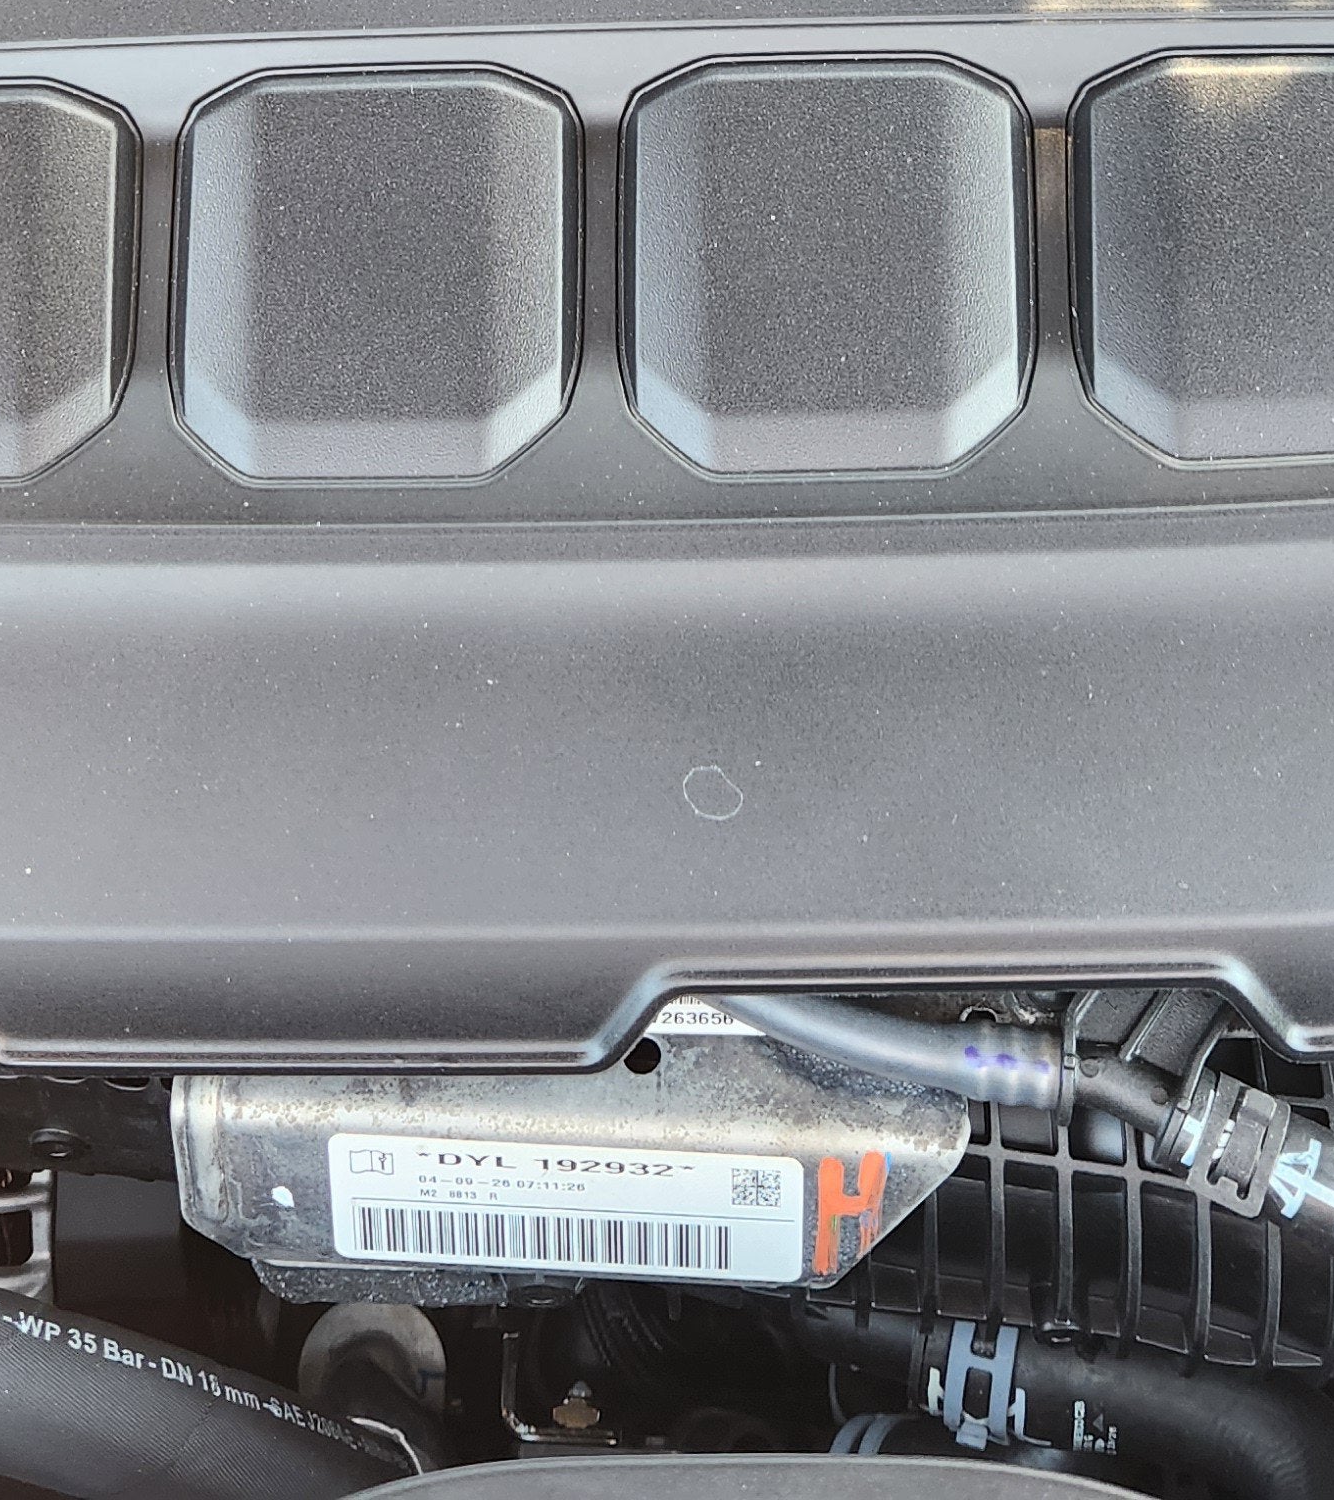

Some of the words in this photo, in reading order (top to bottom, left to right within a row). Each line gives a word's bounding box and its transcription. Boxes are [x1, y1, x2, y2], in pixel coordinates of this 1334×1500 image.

[67, 1328, 98, 1354] 35
[102, 1338, 145, 1369] Bar
[160, 1356, 194, 1387] DN
[224, 1385, 261, 1411] mm
